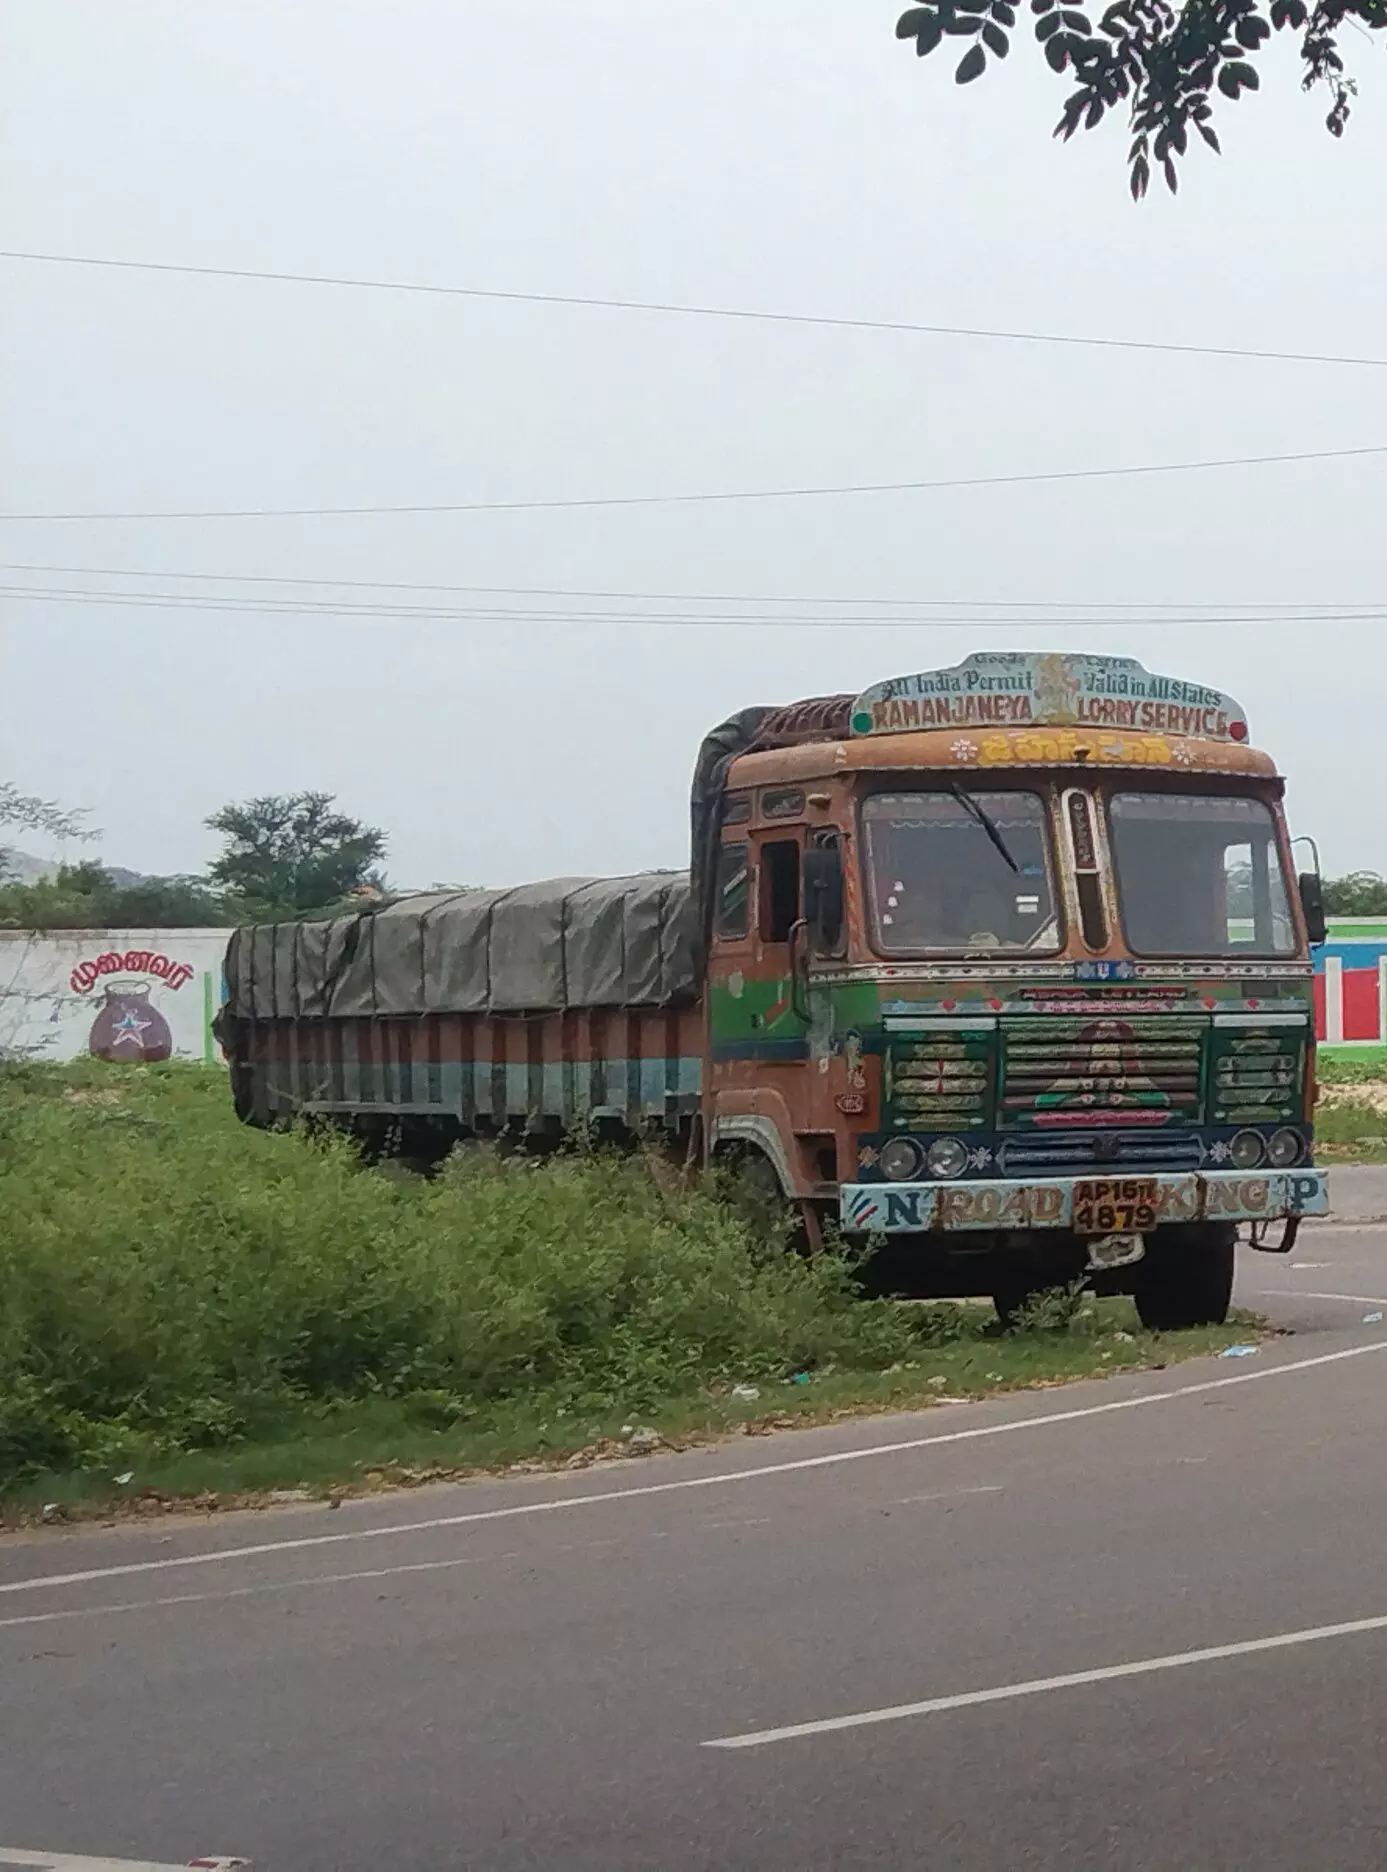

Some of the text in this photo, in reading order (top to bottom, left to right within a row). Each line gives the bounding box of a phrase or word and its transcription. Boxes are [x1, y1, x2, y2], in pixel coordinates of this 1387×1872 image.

[916, 673, 961, 693] India
[963, 670, 1033, 692] Permit
[1083, 671, 1128, 694] Valid
[1130, 676, 1146, 697] in
[1170, 681, 1222, 707] States
[872, 694, 1230, 737] RAMANJANEYA LORRY SERVICE
[942, 1187, 1066, 1222] ROAD
[1155, 1178, 1270, 1215] KING
[1077, 1204, 1156, 1230] 4879
